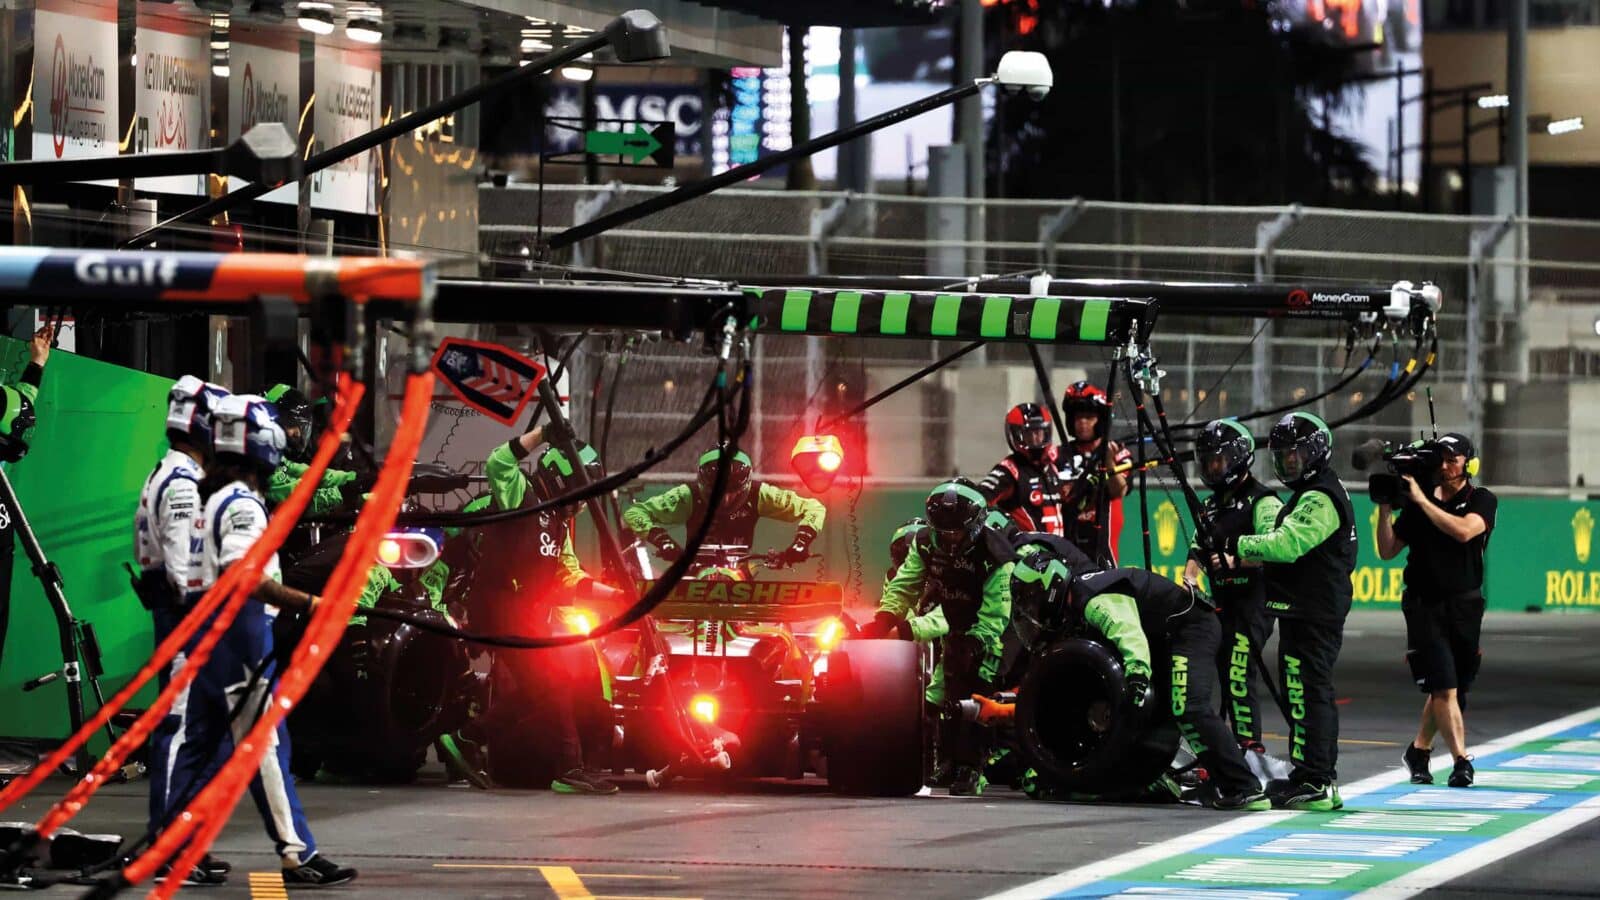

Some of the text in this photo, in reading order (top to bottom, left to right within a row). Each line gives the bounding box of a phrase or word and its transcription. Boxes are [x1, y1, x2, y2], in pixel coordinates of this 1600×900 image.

[68, 52, 105, 106] MoneyGram
[596, 95, 702, 136] MSC
[76, 254, 177, 284] Gulf
[1312, 293, 1369, 303] MoneyGram
[540, 532, 560, 557] Sta
[636, 582, 817, 602] LEASHED
[1546, 570, 1600, 605] ROLE
[1172, 655, 1188, 716] CREW
[1229, 632, 1253, 738] PIT CREW
[1284, 654, 1306, 762] PIT CREW
